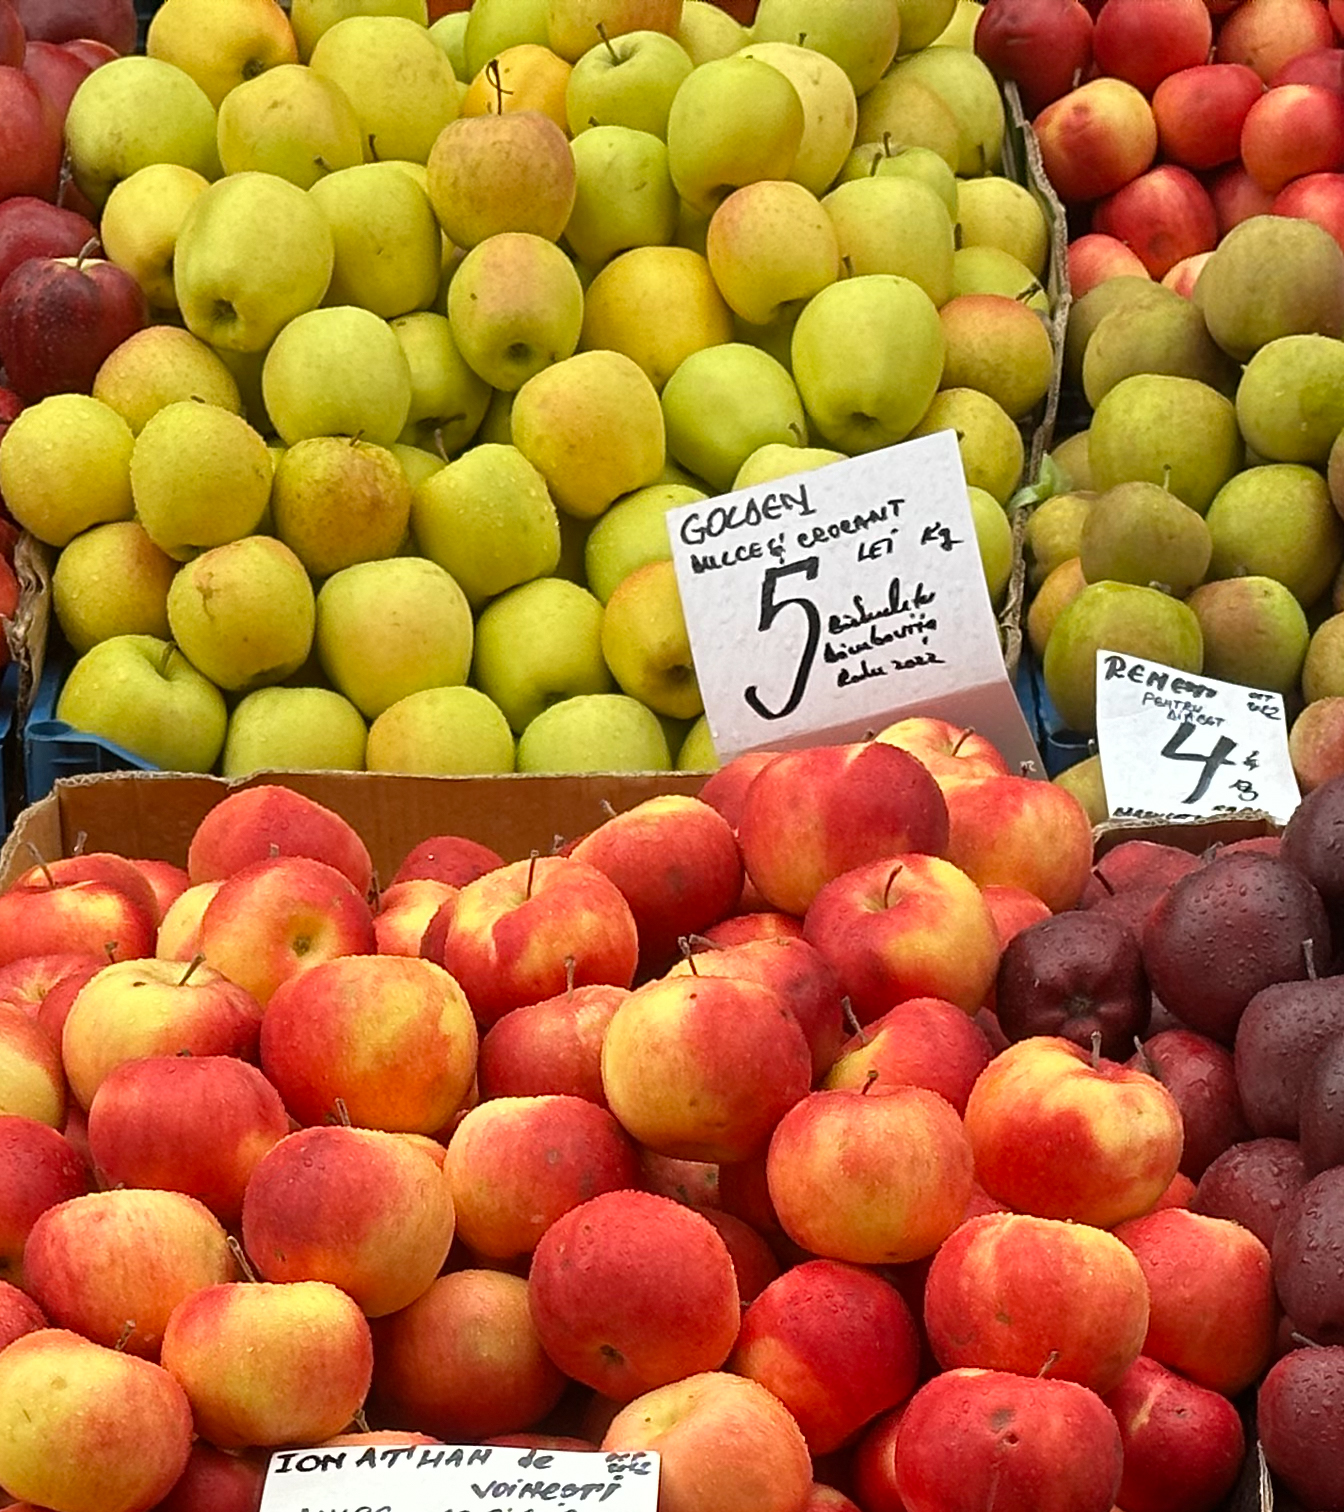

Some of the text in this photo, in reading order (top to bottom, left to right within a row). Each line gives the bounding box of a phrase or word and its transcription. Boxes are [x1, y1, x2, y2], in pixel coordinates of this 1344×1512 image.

[679, 483, 816, 546] GOLDEN
[744, 555, 822, 721] 5
[1160, 720, 1238, 804] 4
